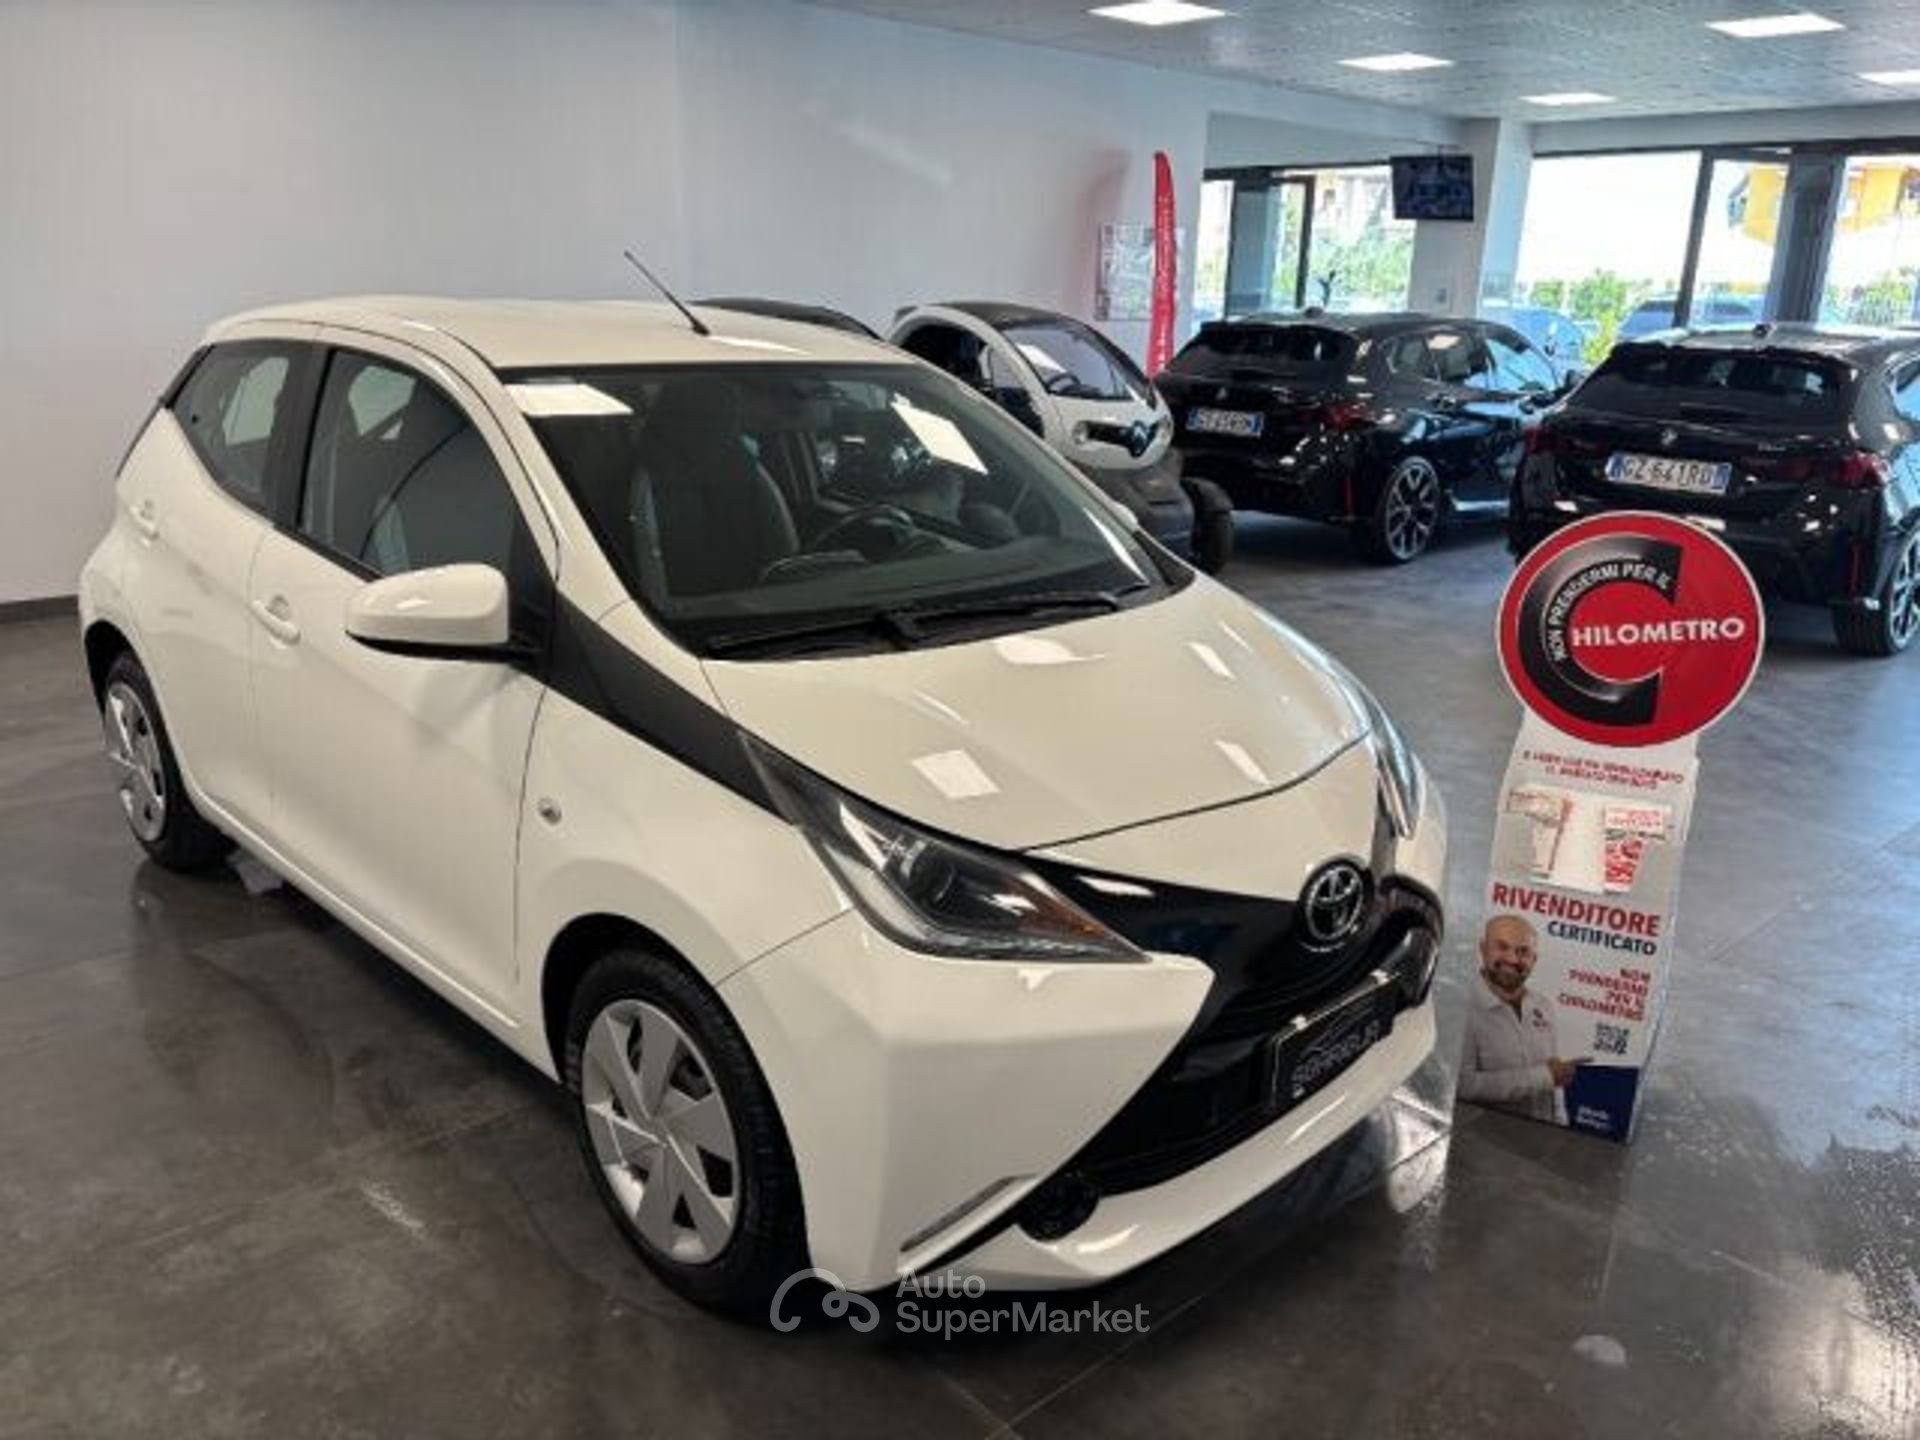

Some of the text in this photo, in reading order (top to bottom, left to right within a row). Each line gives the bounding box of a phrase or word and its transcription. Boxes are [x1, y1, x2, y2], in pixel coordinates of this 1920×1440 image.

[1548, 562, 1618, 626] PRENDERMI
[1622, 562, 1657, 584] PER
[1571, 616, 1746, 647] HILOMETRO
[1492, 881, 1661, 937] RIVENDITORE
[1547, 920, 1658, 956] CERTIFICATO
